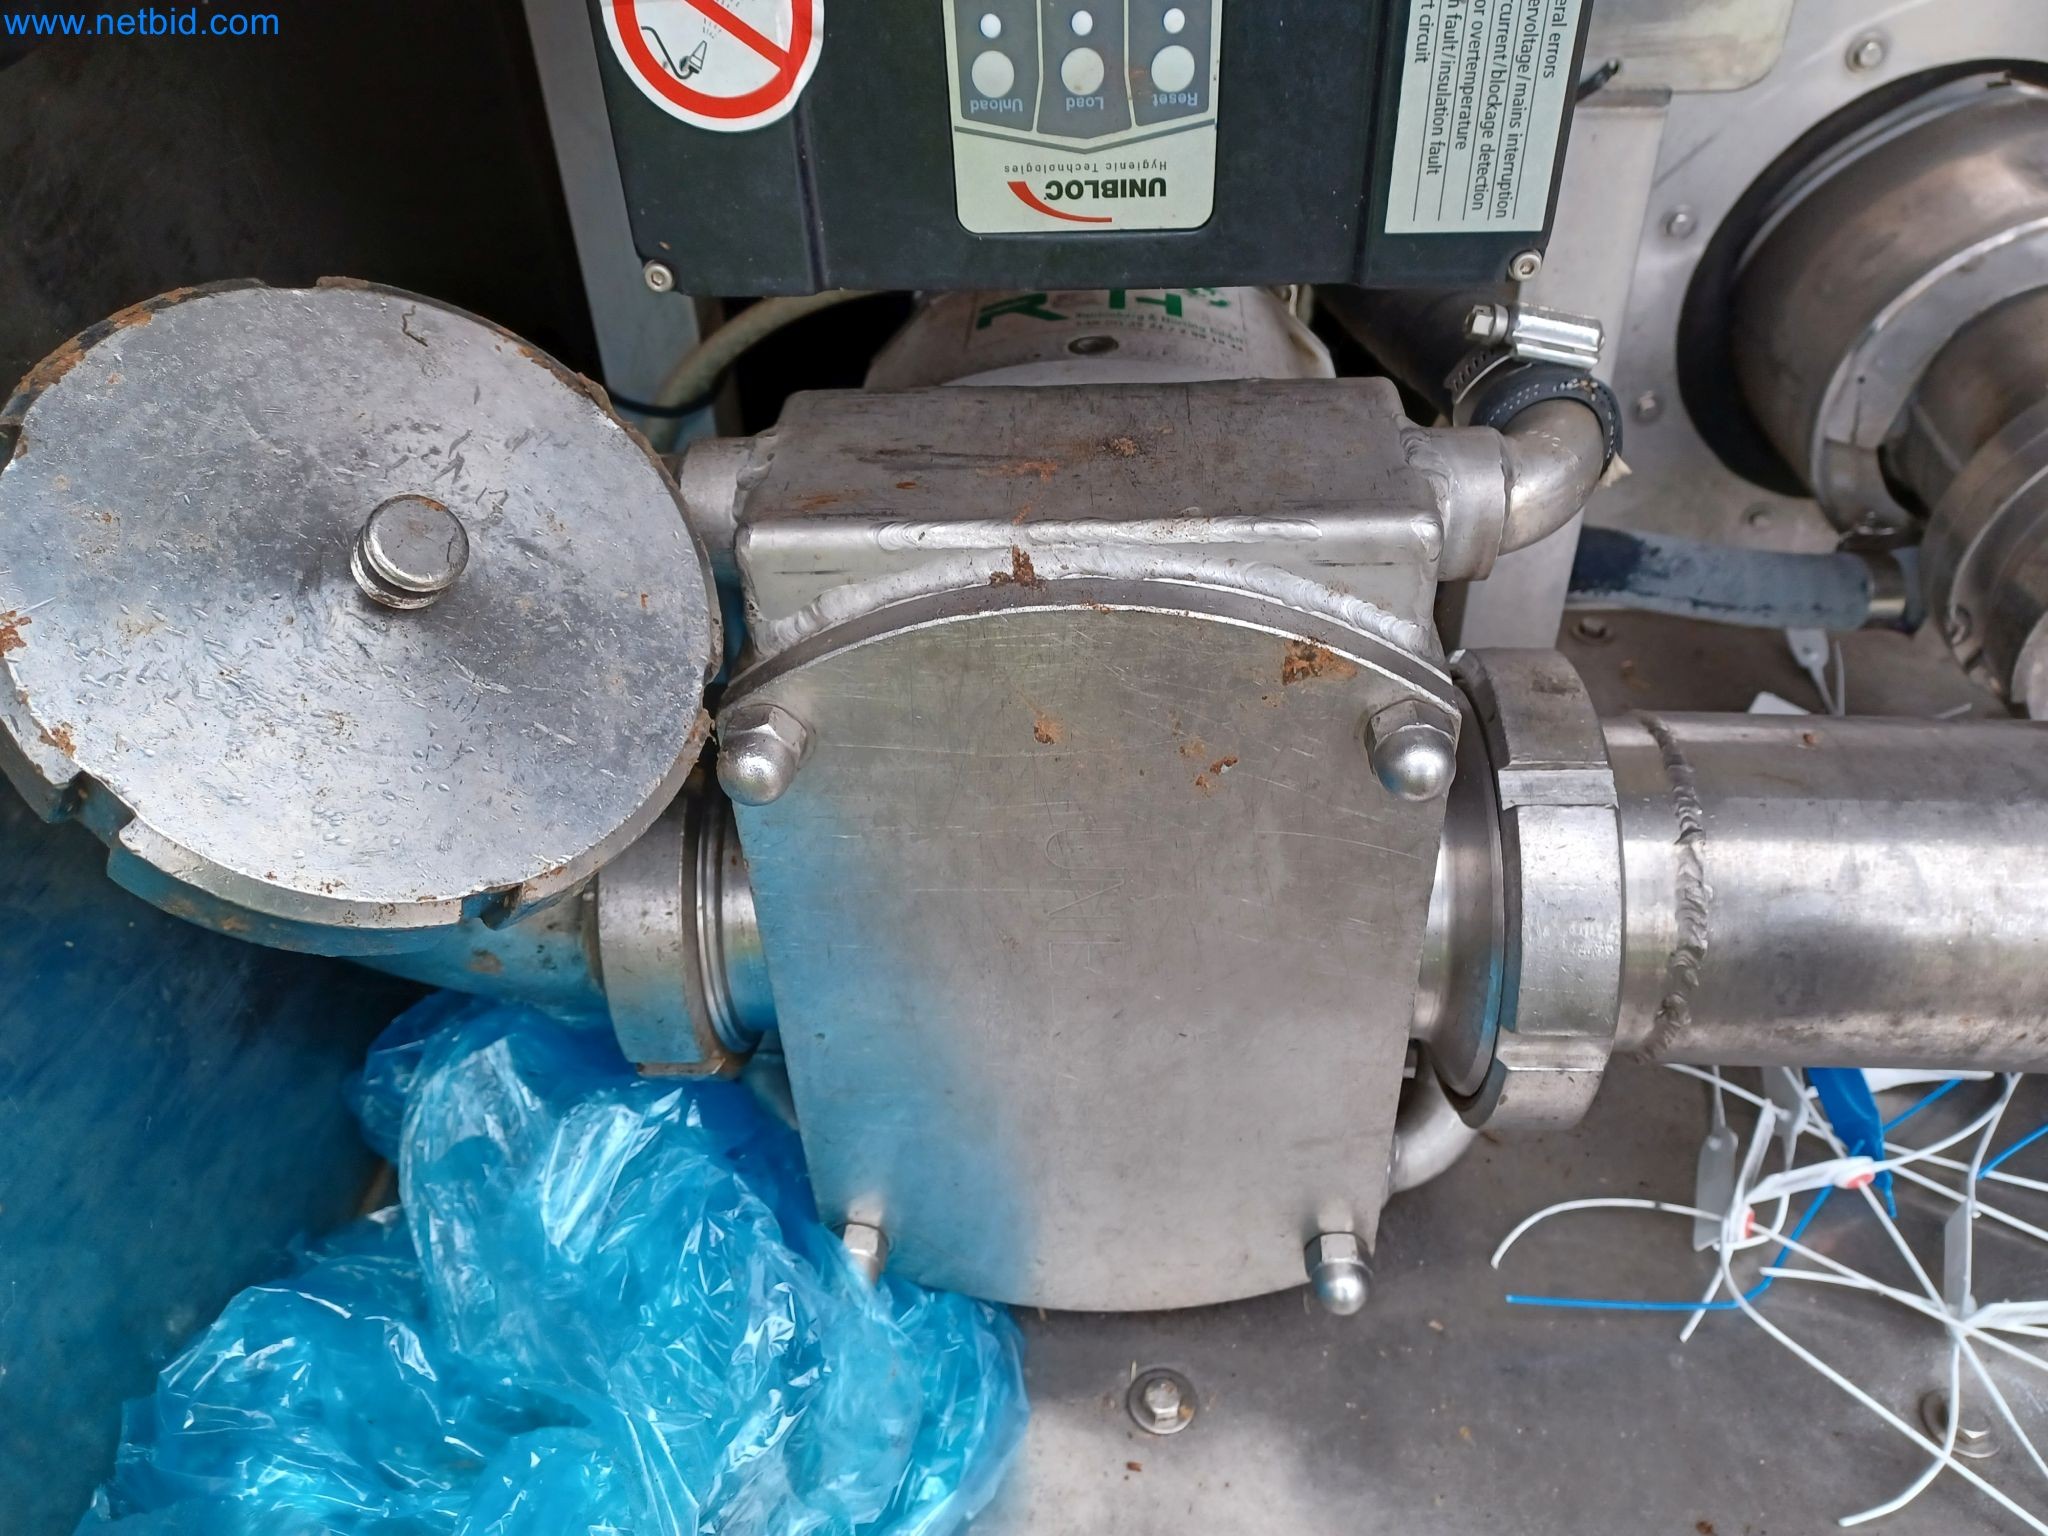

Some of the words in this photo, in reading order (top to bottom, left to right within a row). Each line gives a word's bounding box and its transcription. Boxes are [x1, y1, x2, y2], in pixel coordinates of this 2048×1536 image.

[1414, 14, 1434, 64] circuit
[1543, 33, 1560, 79] errors
[1152, 92, 1198, 107] Reset
[1455, 21, 1483, 151] overtemperature
[970, 98, 1023, 113] Unload
[1065, 96, 1104, 111] Load
[1004, 161, 1098, 174] Technologies
[1105, 159, 1167, 172] Hygienic
[1426, 140, 1445, 176] fault
[1045, 177, 1167, 200] UNIBLOC
[1472, 143, 1495, 211] detection
[1496, 134, 1523, 219] interruption
